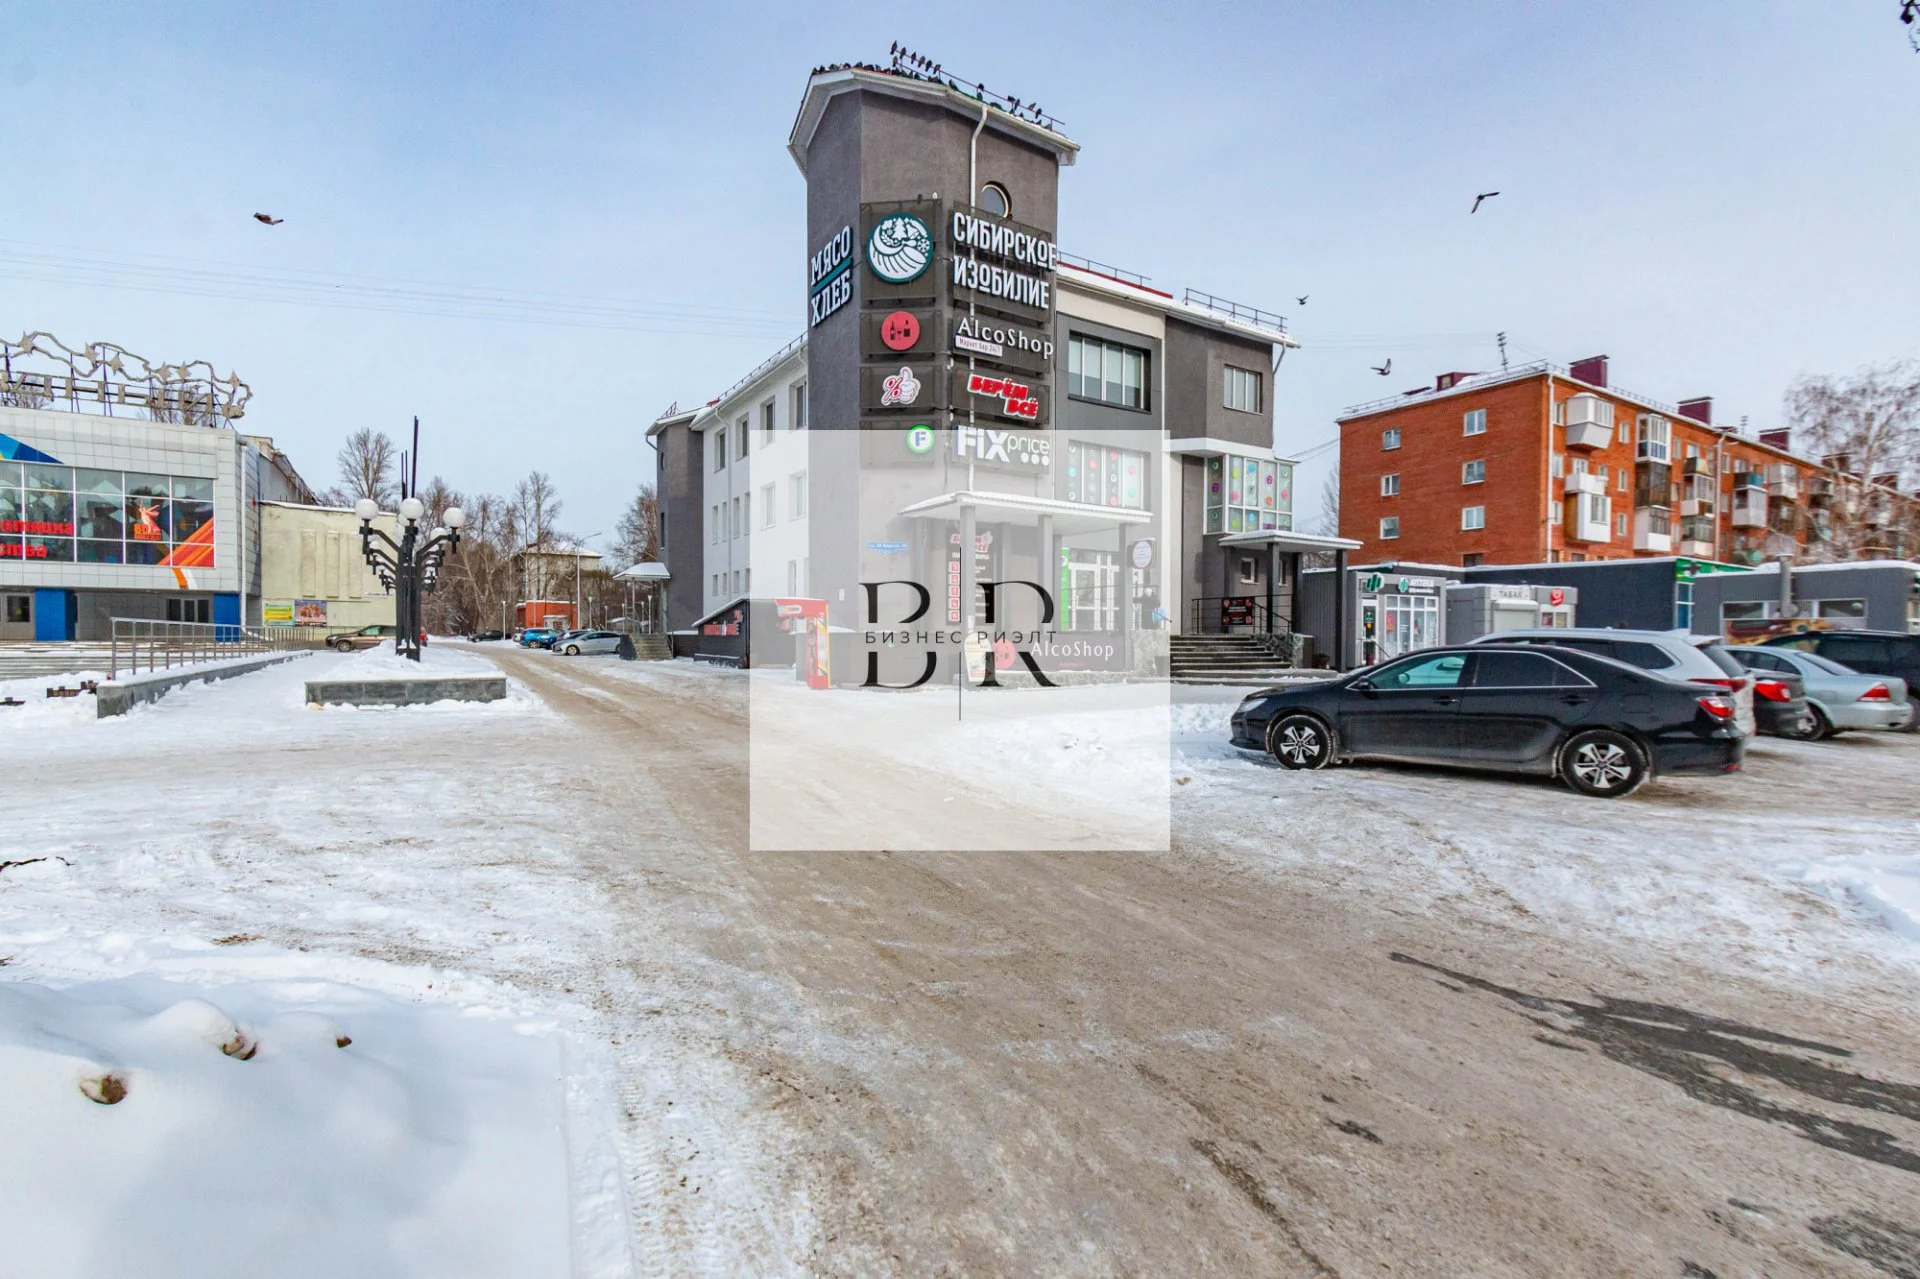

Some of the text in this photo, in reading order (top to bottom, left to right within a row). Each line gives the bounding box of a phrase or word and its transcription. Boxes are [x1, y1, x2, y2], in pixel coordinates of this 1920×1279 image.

[953, 211, 1057, 271] СИБИРСКОЕ
[810, 225, 852, 286] МЯСО
[953, 255, 1050, 310] ИЗОБИЛИЕ
[810, 270, 851, 327] ХЛЕБ
[957, 317, 1054, 360] AlcoShop
[969, 375, 1028, 401] БЕРЁМ
[1006, 398, 1039, 417] ВСЁ
[915, 431, 927, 447] F
[1007, 435, 1050, 454] price
[1499, 590, 1522, 598] ТАБАК
[1031, 641, 1114, 661] AlcoShop
